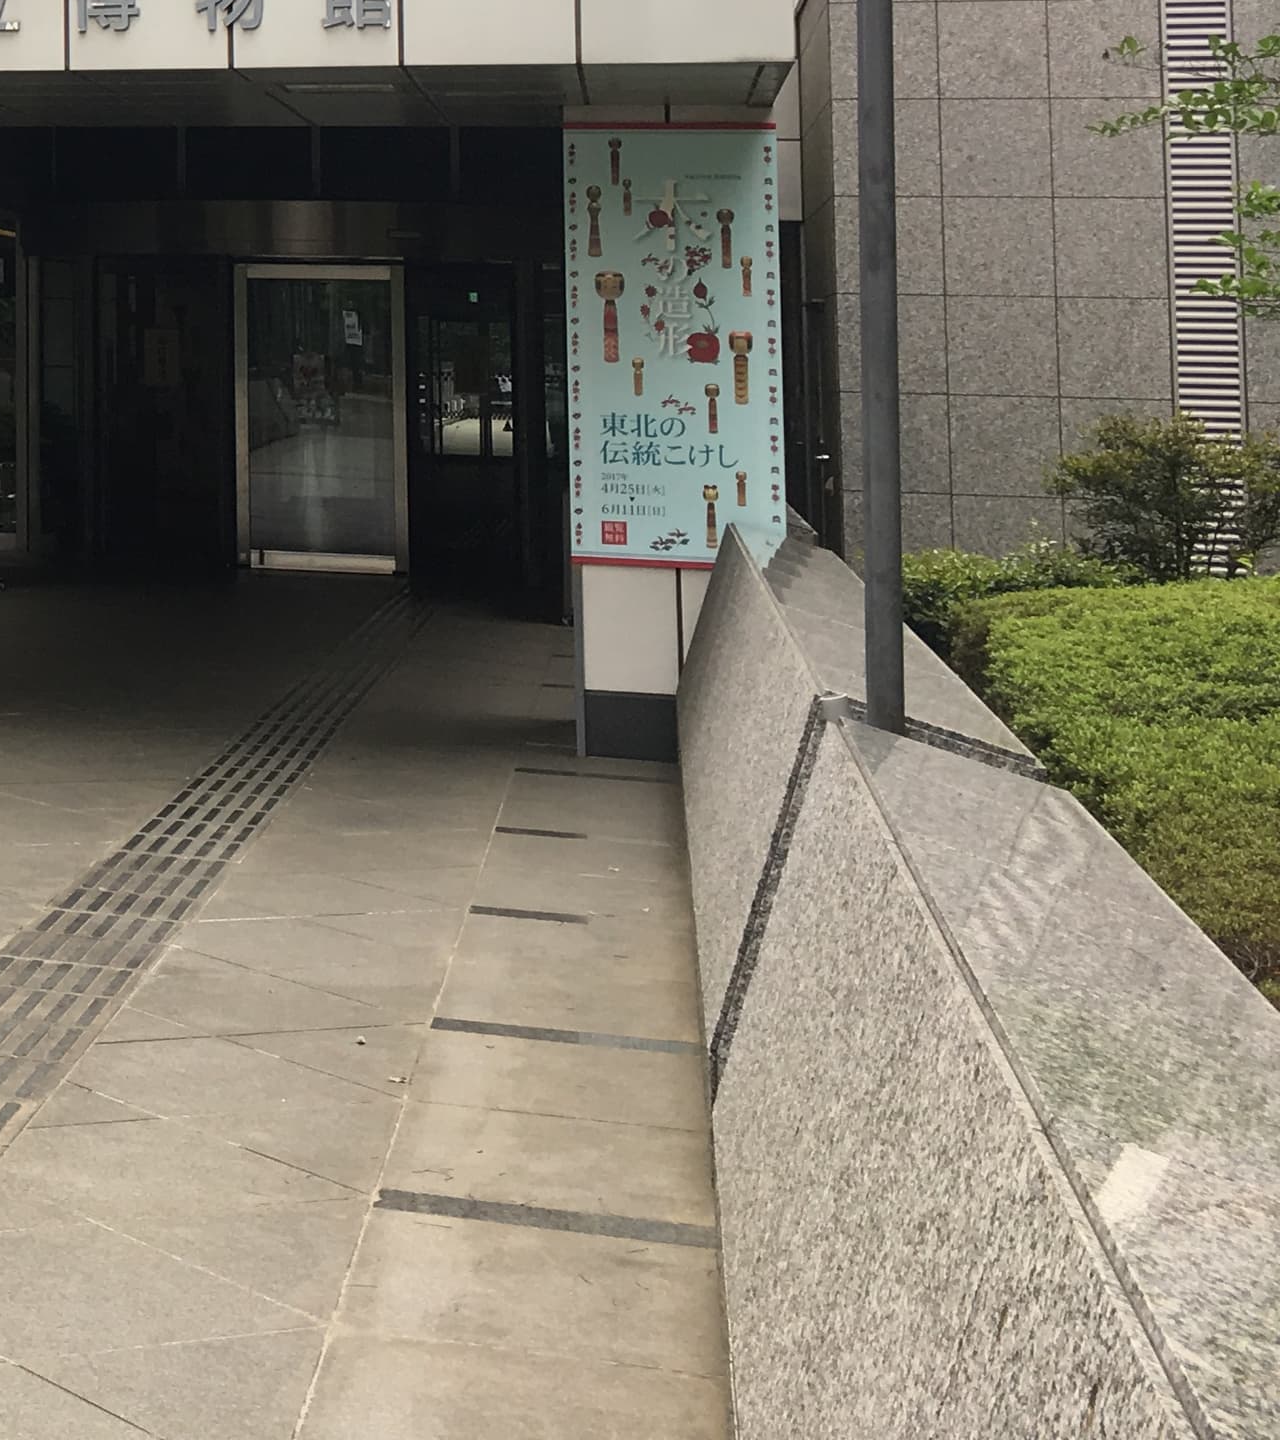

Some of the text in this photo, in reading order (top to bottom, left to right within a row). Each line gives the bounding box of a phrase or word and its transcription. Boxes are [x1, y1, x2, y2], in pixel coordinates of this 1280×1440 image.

[634, 179, 712, 358] 木の造形
[600, 412, 686, 438] 東北の
[600, 440, 739, 468] 伝統こけし
